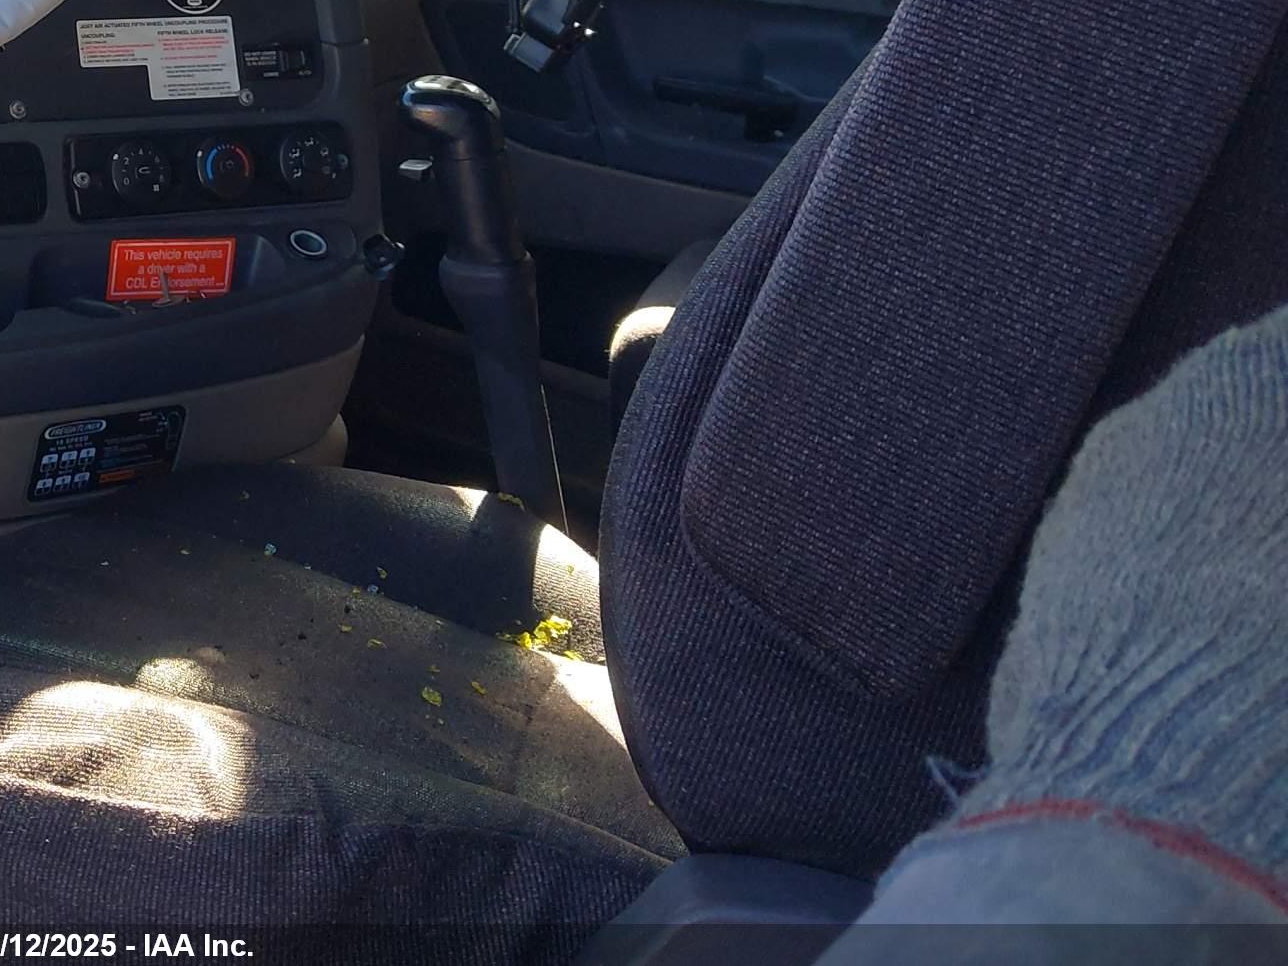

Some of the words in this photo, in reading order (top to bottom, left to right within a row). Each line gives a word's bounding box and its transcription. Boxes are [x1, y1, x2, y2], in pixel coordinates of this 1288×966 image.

[124, 249, 144, 262] This
[147, 248, 183, 261] vehicle
[183, 248, 223, 263] requires
[137, 265, 144, 275] a
[147, 263, 175, 275] driver
[177, 262, 197, 274] with
[198, 264, 206, 274] a
[126, 276, 147, 289] CDL
